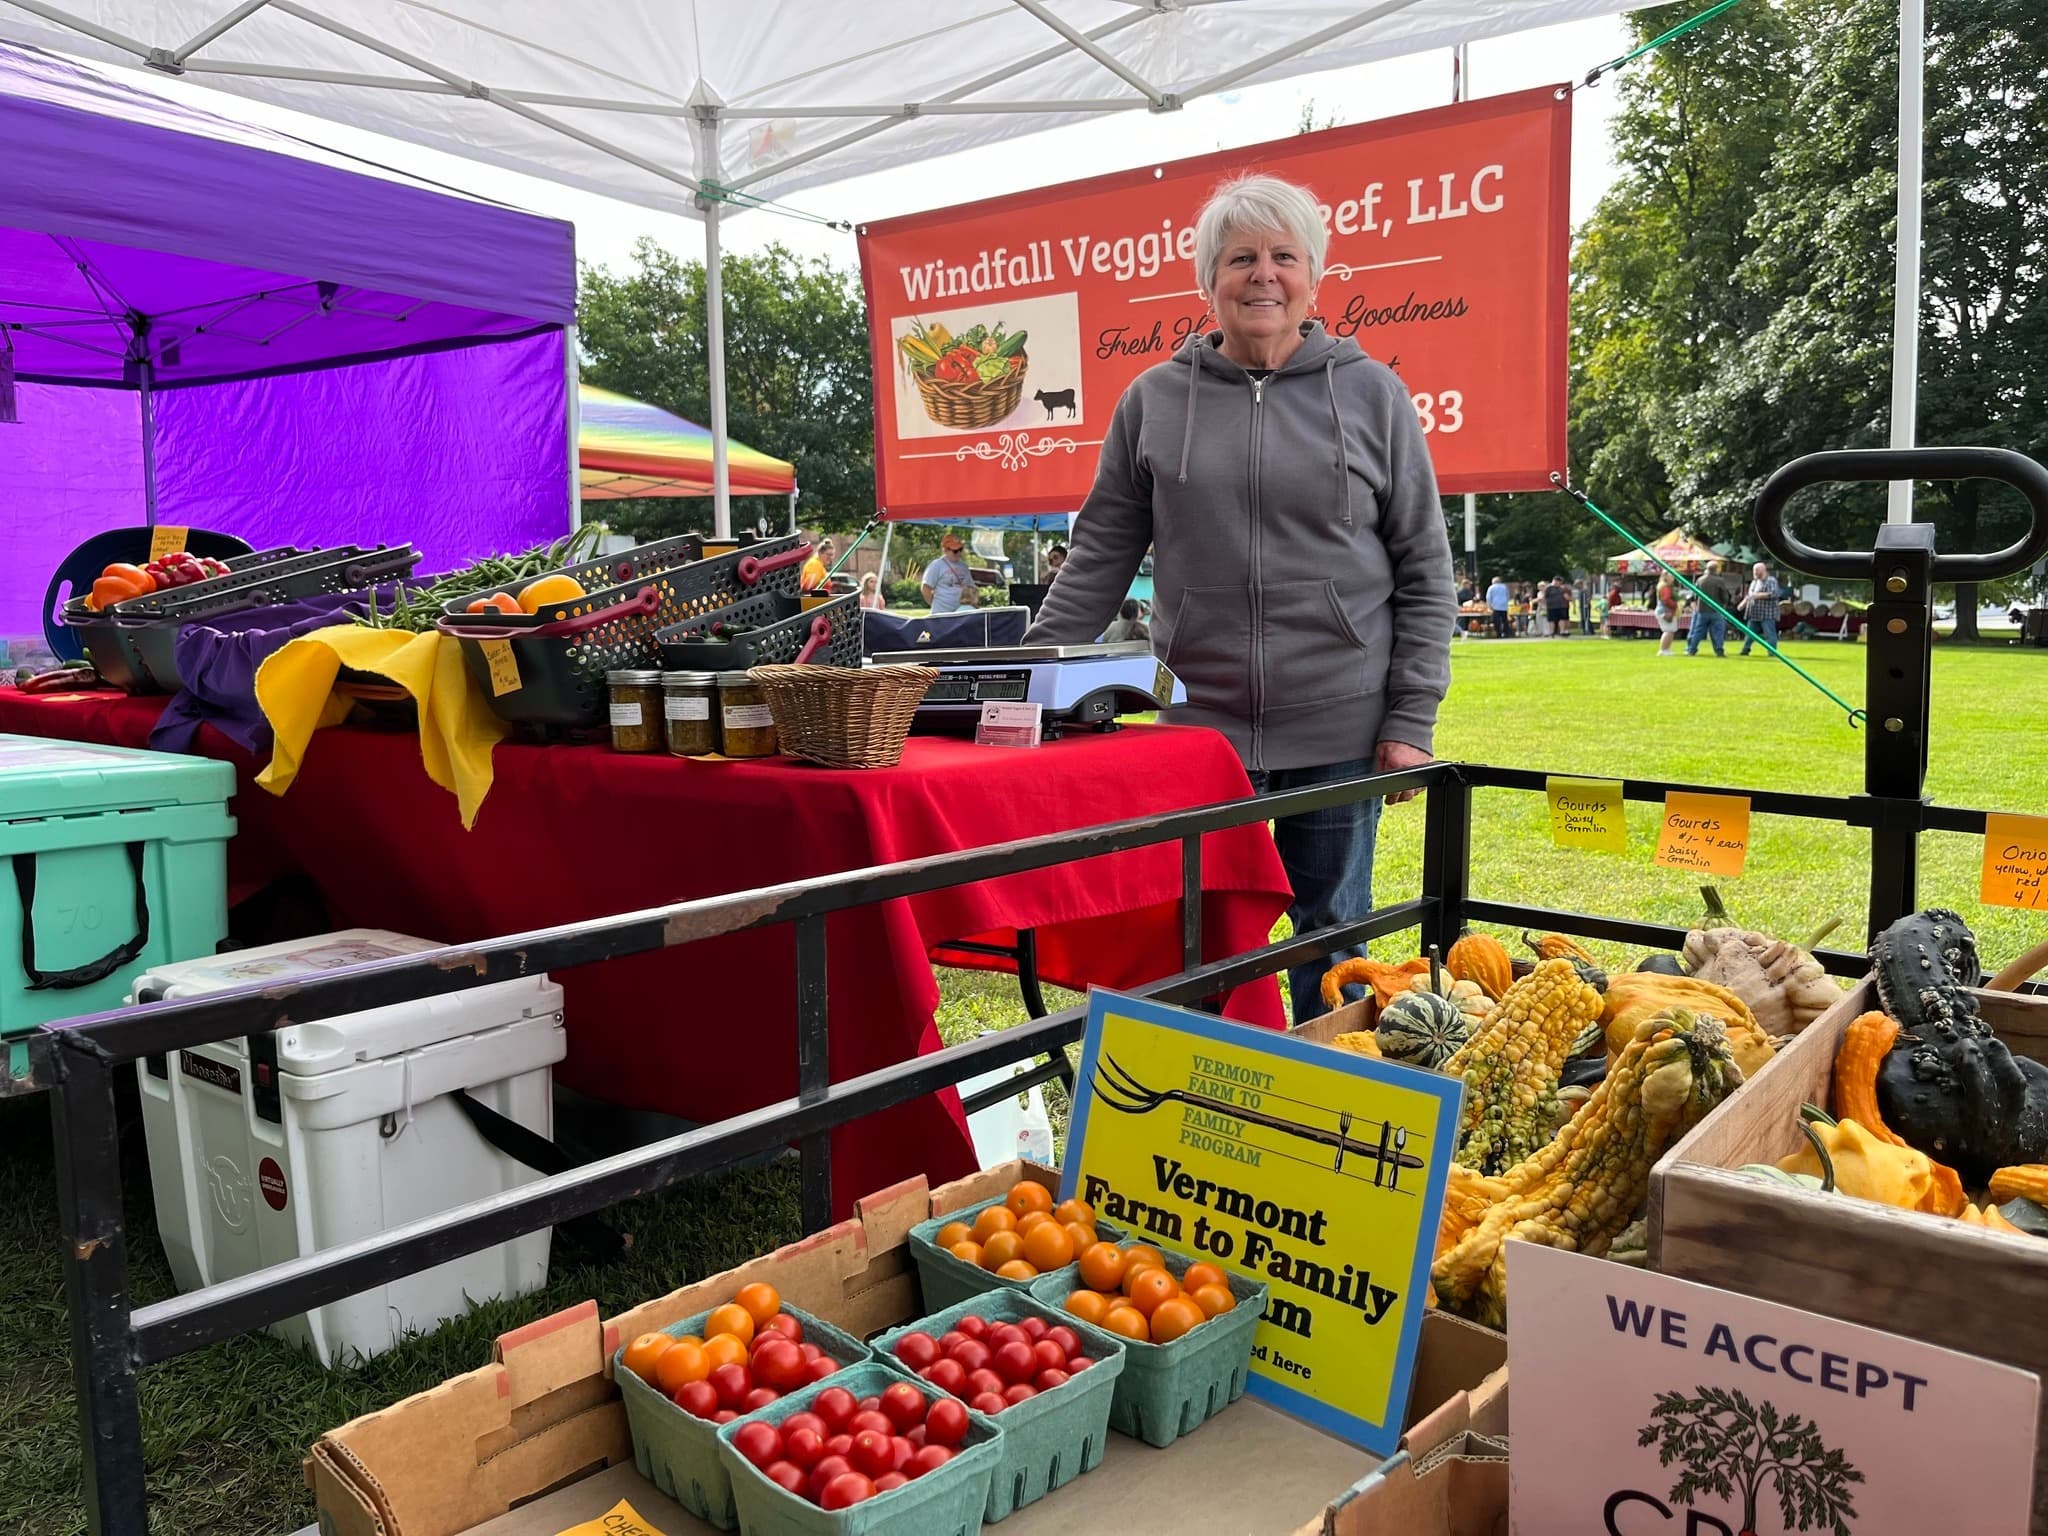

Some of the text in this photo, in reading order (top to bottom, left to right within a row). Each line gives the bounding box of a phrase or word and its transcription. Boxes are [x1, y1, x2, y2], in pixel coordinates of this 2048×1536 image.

[900, 239, 1055, 302] Windfall
[1406, 164, 1505, 226] LLC
[1096, 320, 1164, 360] Fresh
[1335, 290, 1469, 338] Goodness
[1557, 796, 1607, 812] Gourds
[1564, 813, 1593, 826] Daisy
[1564, 823, 1607, 833] Gremlin
[1667, 813, 1721, 831] Gourds
[1668, 844, 1698, 859] Daisy
[1705, 836, 1715, 846] 4
[1716, 840, 1744, 851] each
[1666, 855, 1711, 867] Gremlin
[2016, 875, 2040, 887] red
[2014, 890, 2024, 903] 4
[1191, 1054, 1274, 1091] VERMONT
[1187, 1075, 1261, 1111] FARM TO
[1181, 1106, 1247, 1139] FAMILY
[1178, 1129, 1262, 1168] PROGRAM
[1152, 1154, 1328, 1247] Vermont
[1085, 1174, 1182, 1242] Farm
[1193, 1215, 1234, 1259] to
[1240, 1229, 1399, 1326] Family
[1272, 1350, 1312, 1379] here
[1605, 1294, 1928, 1412] WE ACCEPT
